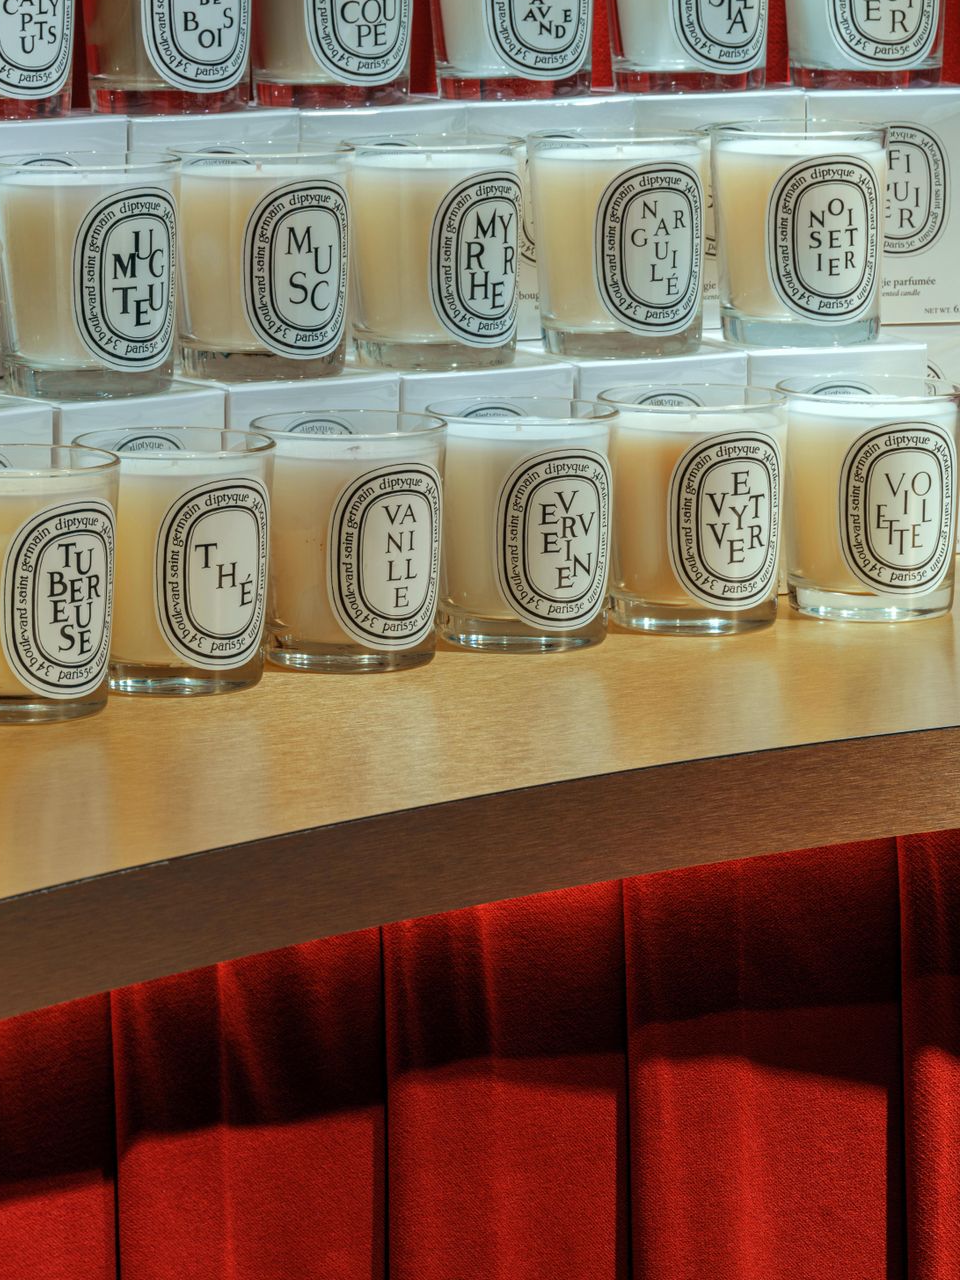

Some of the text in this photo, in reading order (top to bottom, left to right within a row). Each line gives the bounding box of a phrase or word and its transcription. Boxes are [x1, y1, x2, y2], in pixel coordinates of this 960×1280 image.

[638, 174, 682, 188] diptyque
[475, 184, 512, 198] diptyque
[289, 192, 331, 207] diptyque
[119, 201, 161, 215] diptyque
[778, 168, 856, 301] boulevard saint germain diptyque
[893, 275, 937, 287] parfumée
[900, 288, 921, 297] candle
[715, 443, 761, 457] diptyque
[544, 461, 590, 476] diptyque
[849, 434, 931, 572] boulevard saint germain diptyque
[54, 516, 99, 531] diptyque
[342, 475, 423, 623] boulevard saint germain diptyque
[167, 490, 250, 640] boulevard saint germain diptyque
